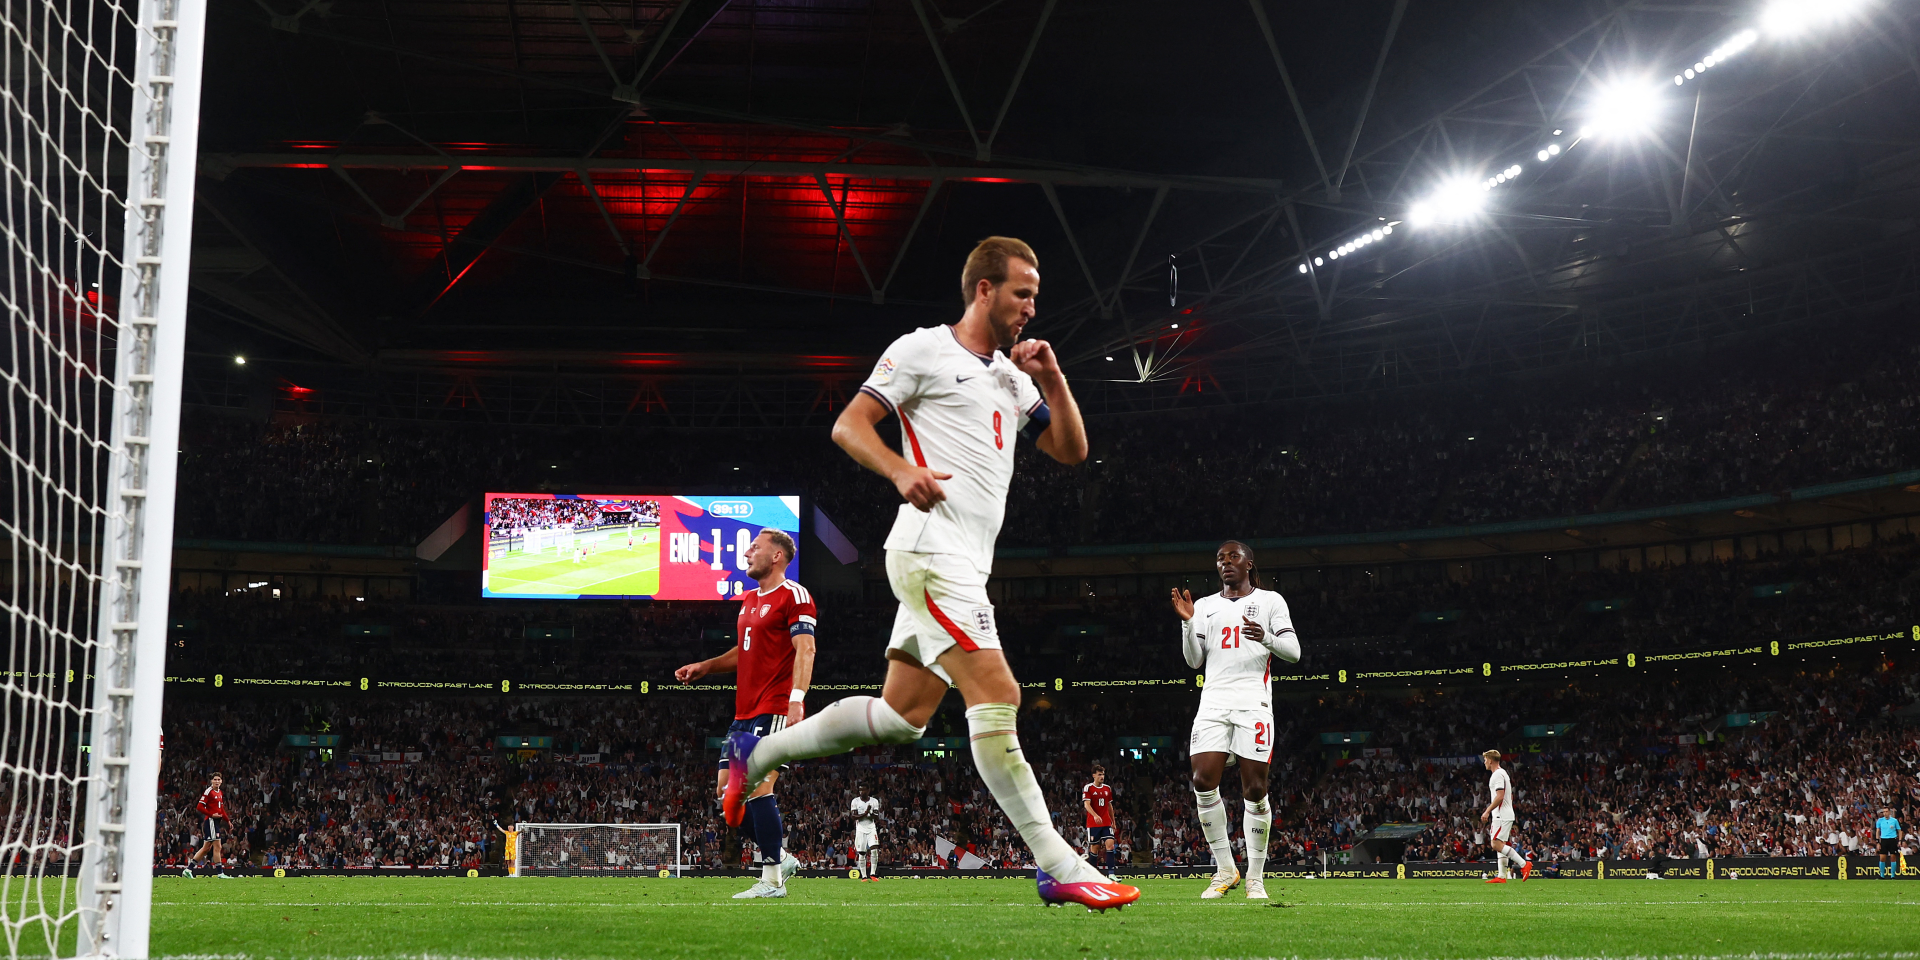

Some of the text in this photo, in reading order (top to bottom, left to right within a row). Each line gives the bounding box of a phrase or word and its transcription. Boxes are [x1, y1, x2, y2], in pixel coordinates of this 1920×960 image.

[993, 410, 1003, 450] 9
[713, 504, 747, 514] 39:12
[669, 532, 699, 562] ENG
[743, 626, 752, 651] 5
[1221, 625, 1240, 649] 21
[1788, 631, 1905, 650] INTRODUCING FAST LANE
[1645, 646, 1763, 662] INTRODUCING FAST LANE
[1501, 658, 1619, 672] INTRODUCING FAST LANE
[1356, 670, 1424, 679] INTRODUCING
[1425, 668, 1449, 676] FAST
[234, 678, 301, 686] INTRODUCING
[377, 681, 444, 689] INTRODUCING
[1255, 721, 1271, 747] 21
[1362, 870, 1390, 878] LANE
[1412, 870, 1464, 878] INTRODUCING
[1560, 869, 1593, 877] FAST LANE
[1663, 868, 1678, 877] AST
[1679, 867, 1701, 877] LANE
[1781, 866, 1804, 876] FAST
[1804, 866, 1830, 876] LANE
